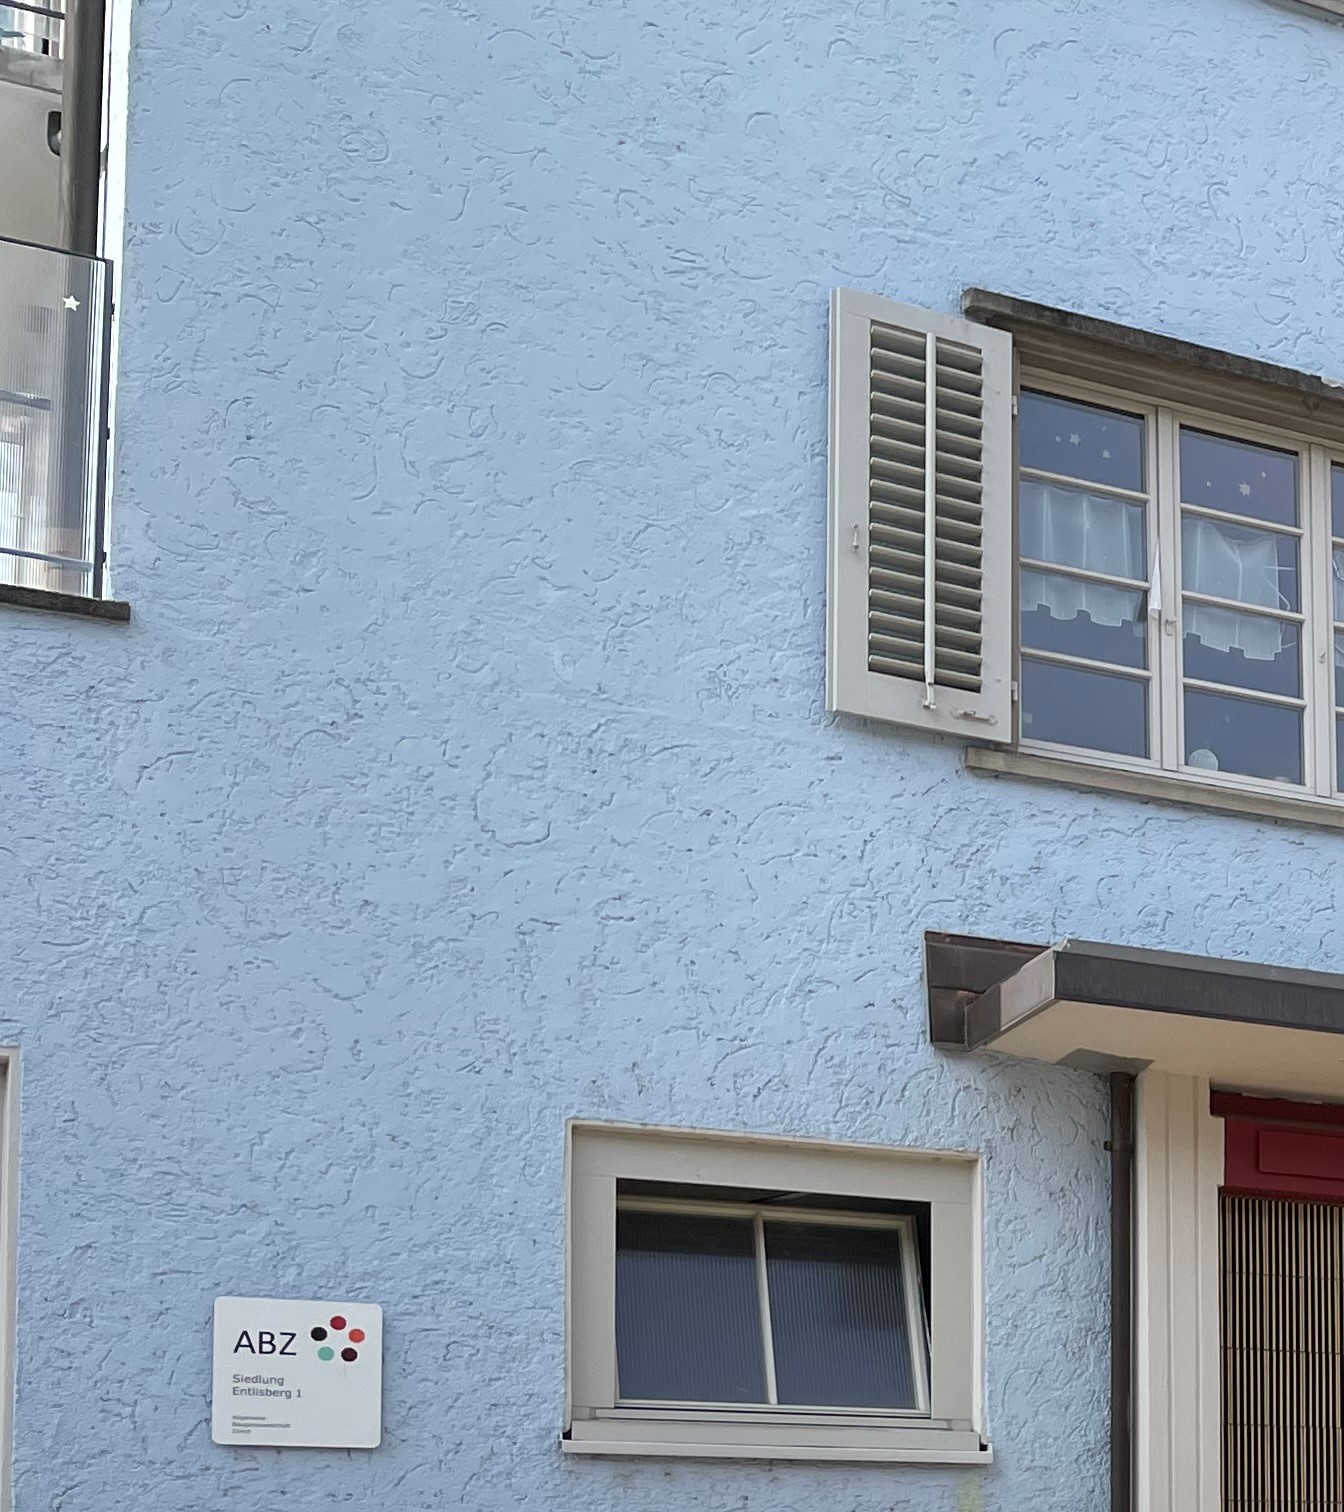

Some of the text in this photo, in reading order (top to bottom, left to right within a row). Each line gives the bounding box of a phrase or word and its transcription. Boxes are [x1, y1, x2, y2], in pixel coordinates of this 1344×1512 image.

[233, 1330, 297, 1356] ABZ
[232, 1373, 285, 1387] Siedlung
[232, 1386, 302, 1400] Entlisberg 1
